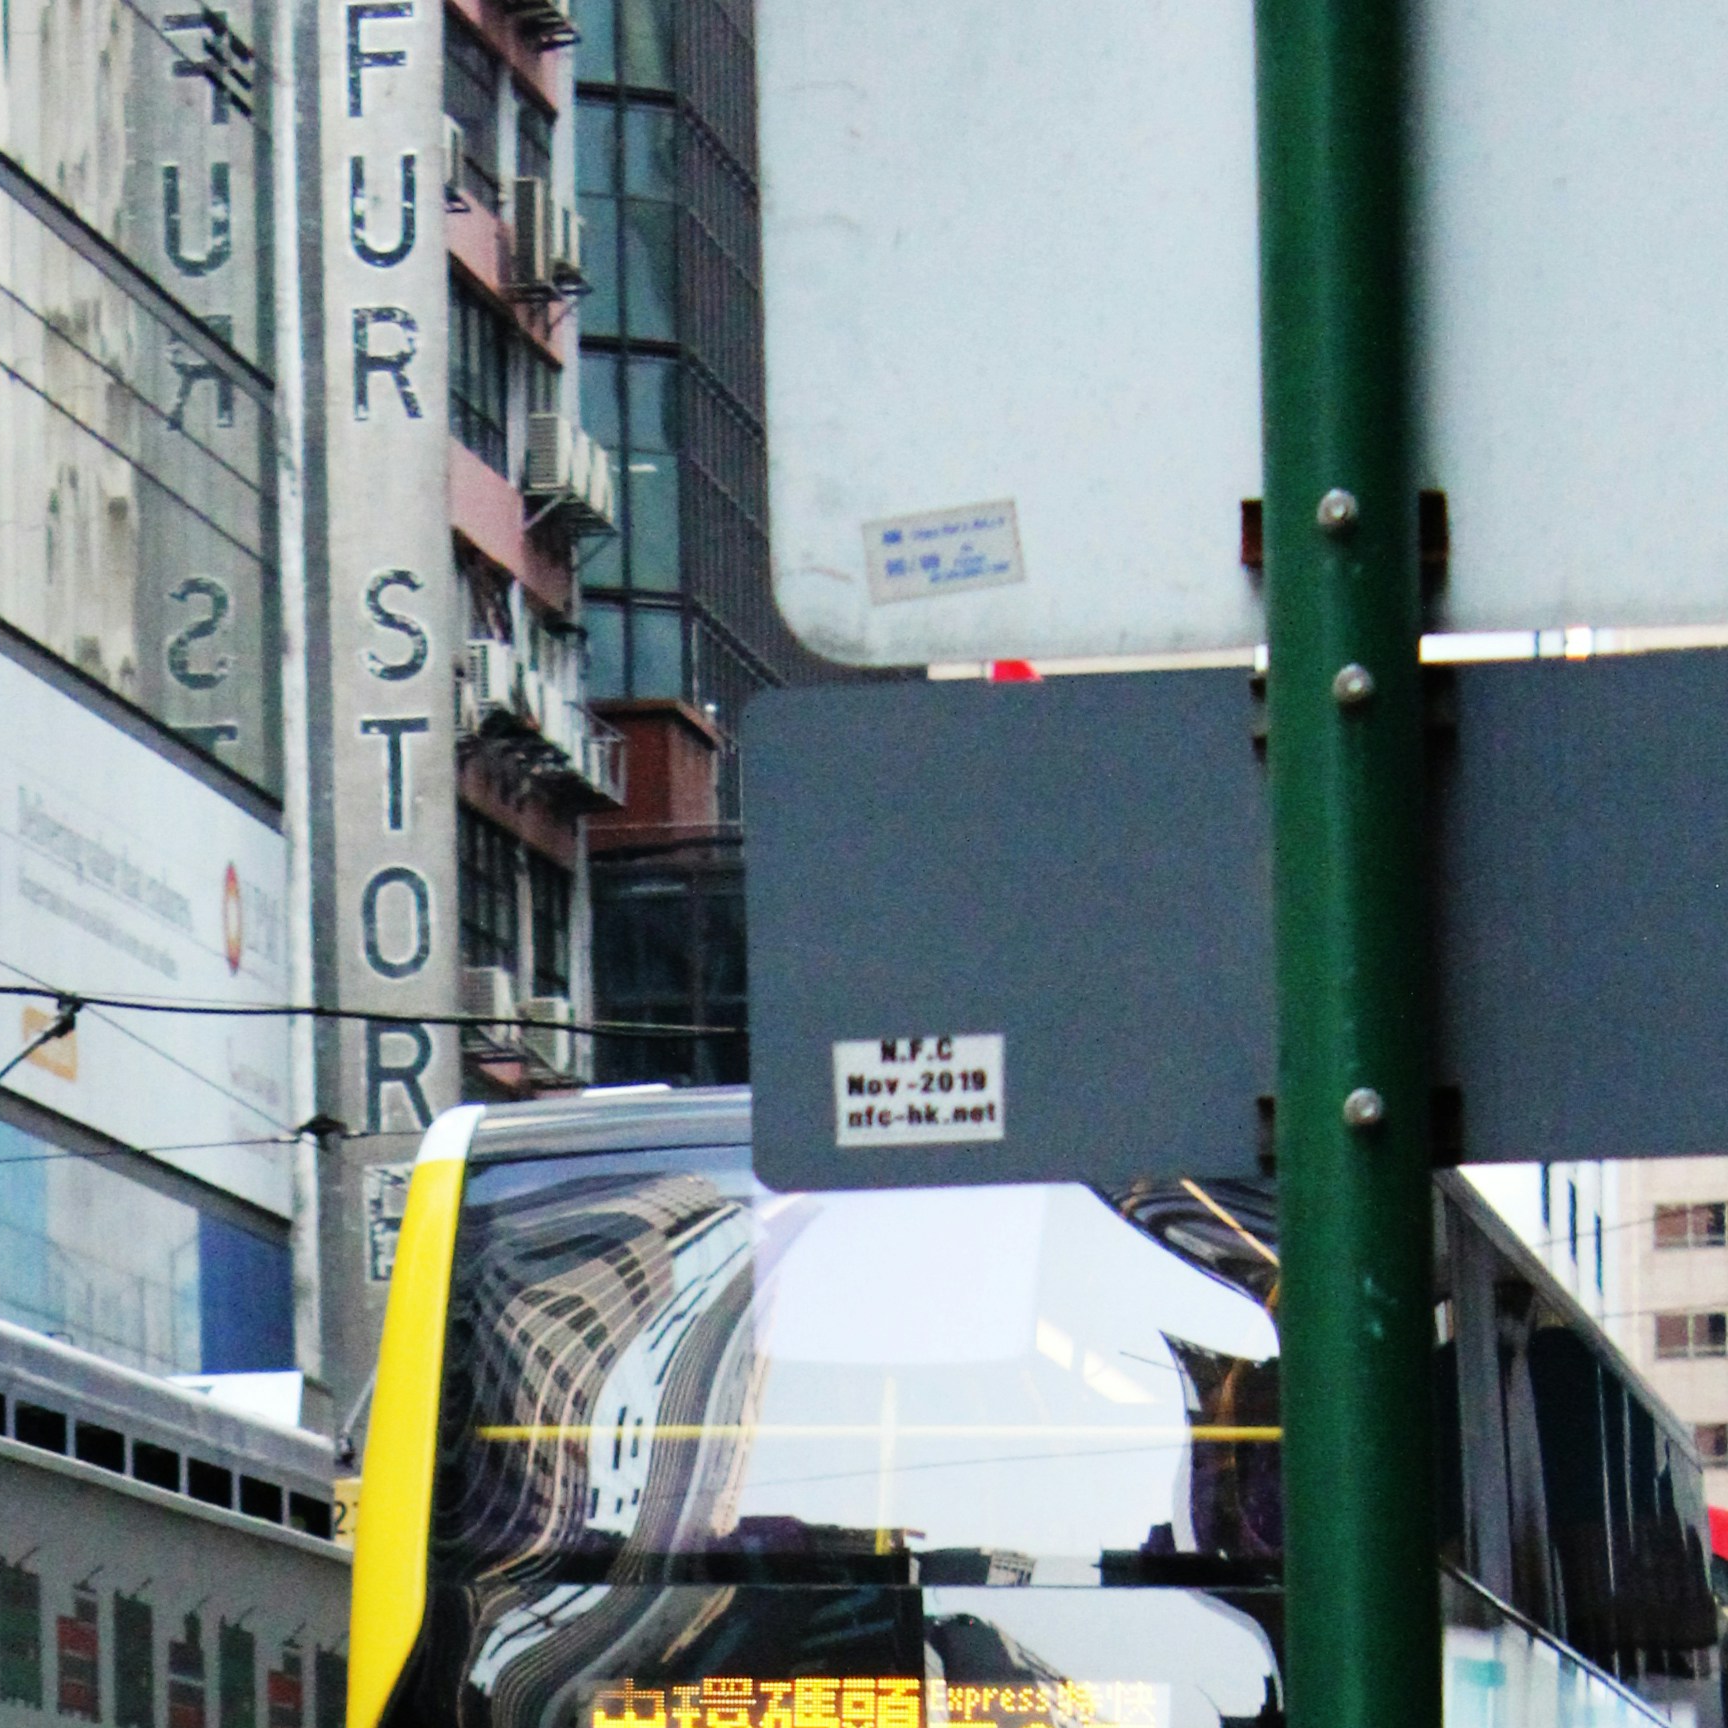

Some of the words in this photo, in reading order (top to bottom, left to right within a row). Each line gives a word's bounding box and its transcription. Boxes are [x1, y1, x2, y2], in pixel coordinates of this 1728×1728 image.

[345, 3, 424, 421] FUR
[848, 1101, 995, 1128] nfc-hk.net
[929, 1680, 1050, 1720] Express
